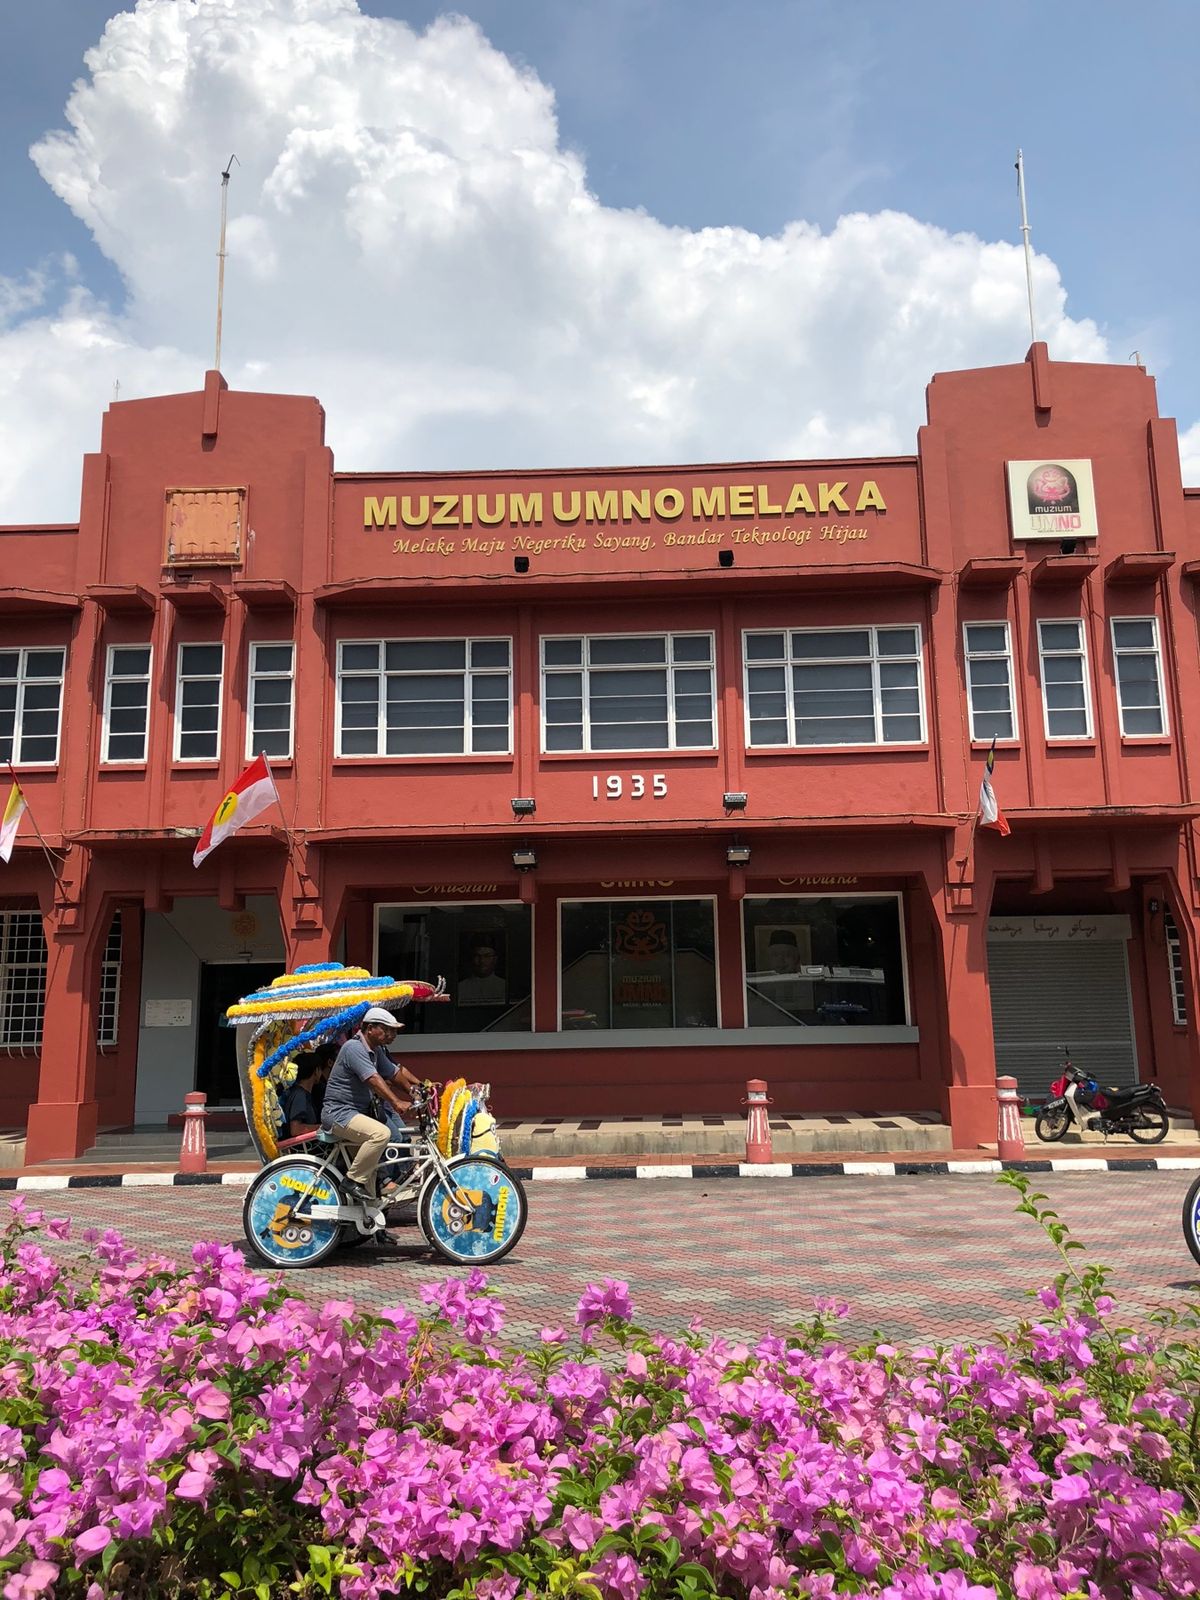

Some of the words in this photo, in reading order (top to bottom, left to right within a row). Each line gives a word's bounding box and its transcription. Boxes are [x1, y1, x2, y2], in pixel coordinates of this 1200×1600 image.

[364, 493, 543, 526] MUZIUM
[553, 488, 685, 522] UMNO
[692, 481, 887, 517] MELAKA
[1034, 505, 1072, 513] muzium
[1031, 515, 1082, 531] UMNO
[392, 536, 455, 556] Melaka
[461, 537, 506, 556] Maju
[511, 533, 587, 555] Negeriku
[593, 532, 656, 553] Sayang,
[664, 529, 725, 547] Bandar
[731, 526, 812, 547] Teknologi
[819, 525, 868, 544] Hijau
[592, 774, 668, 798] 1935
[493, 1185, 510, 1242] minions
